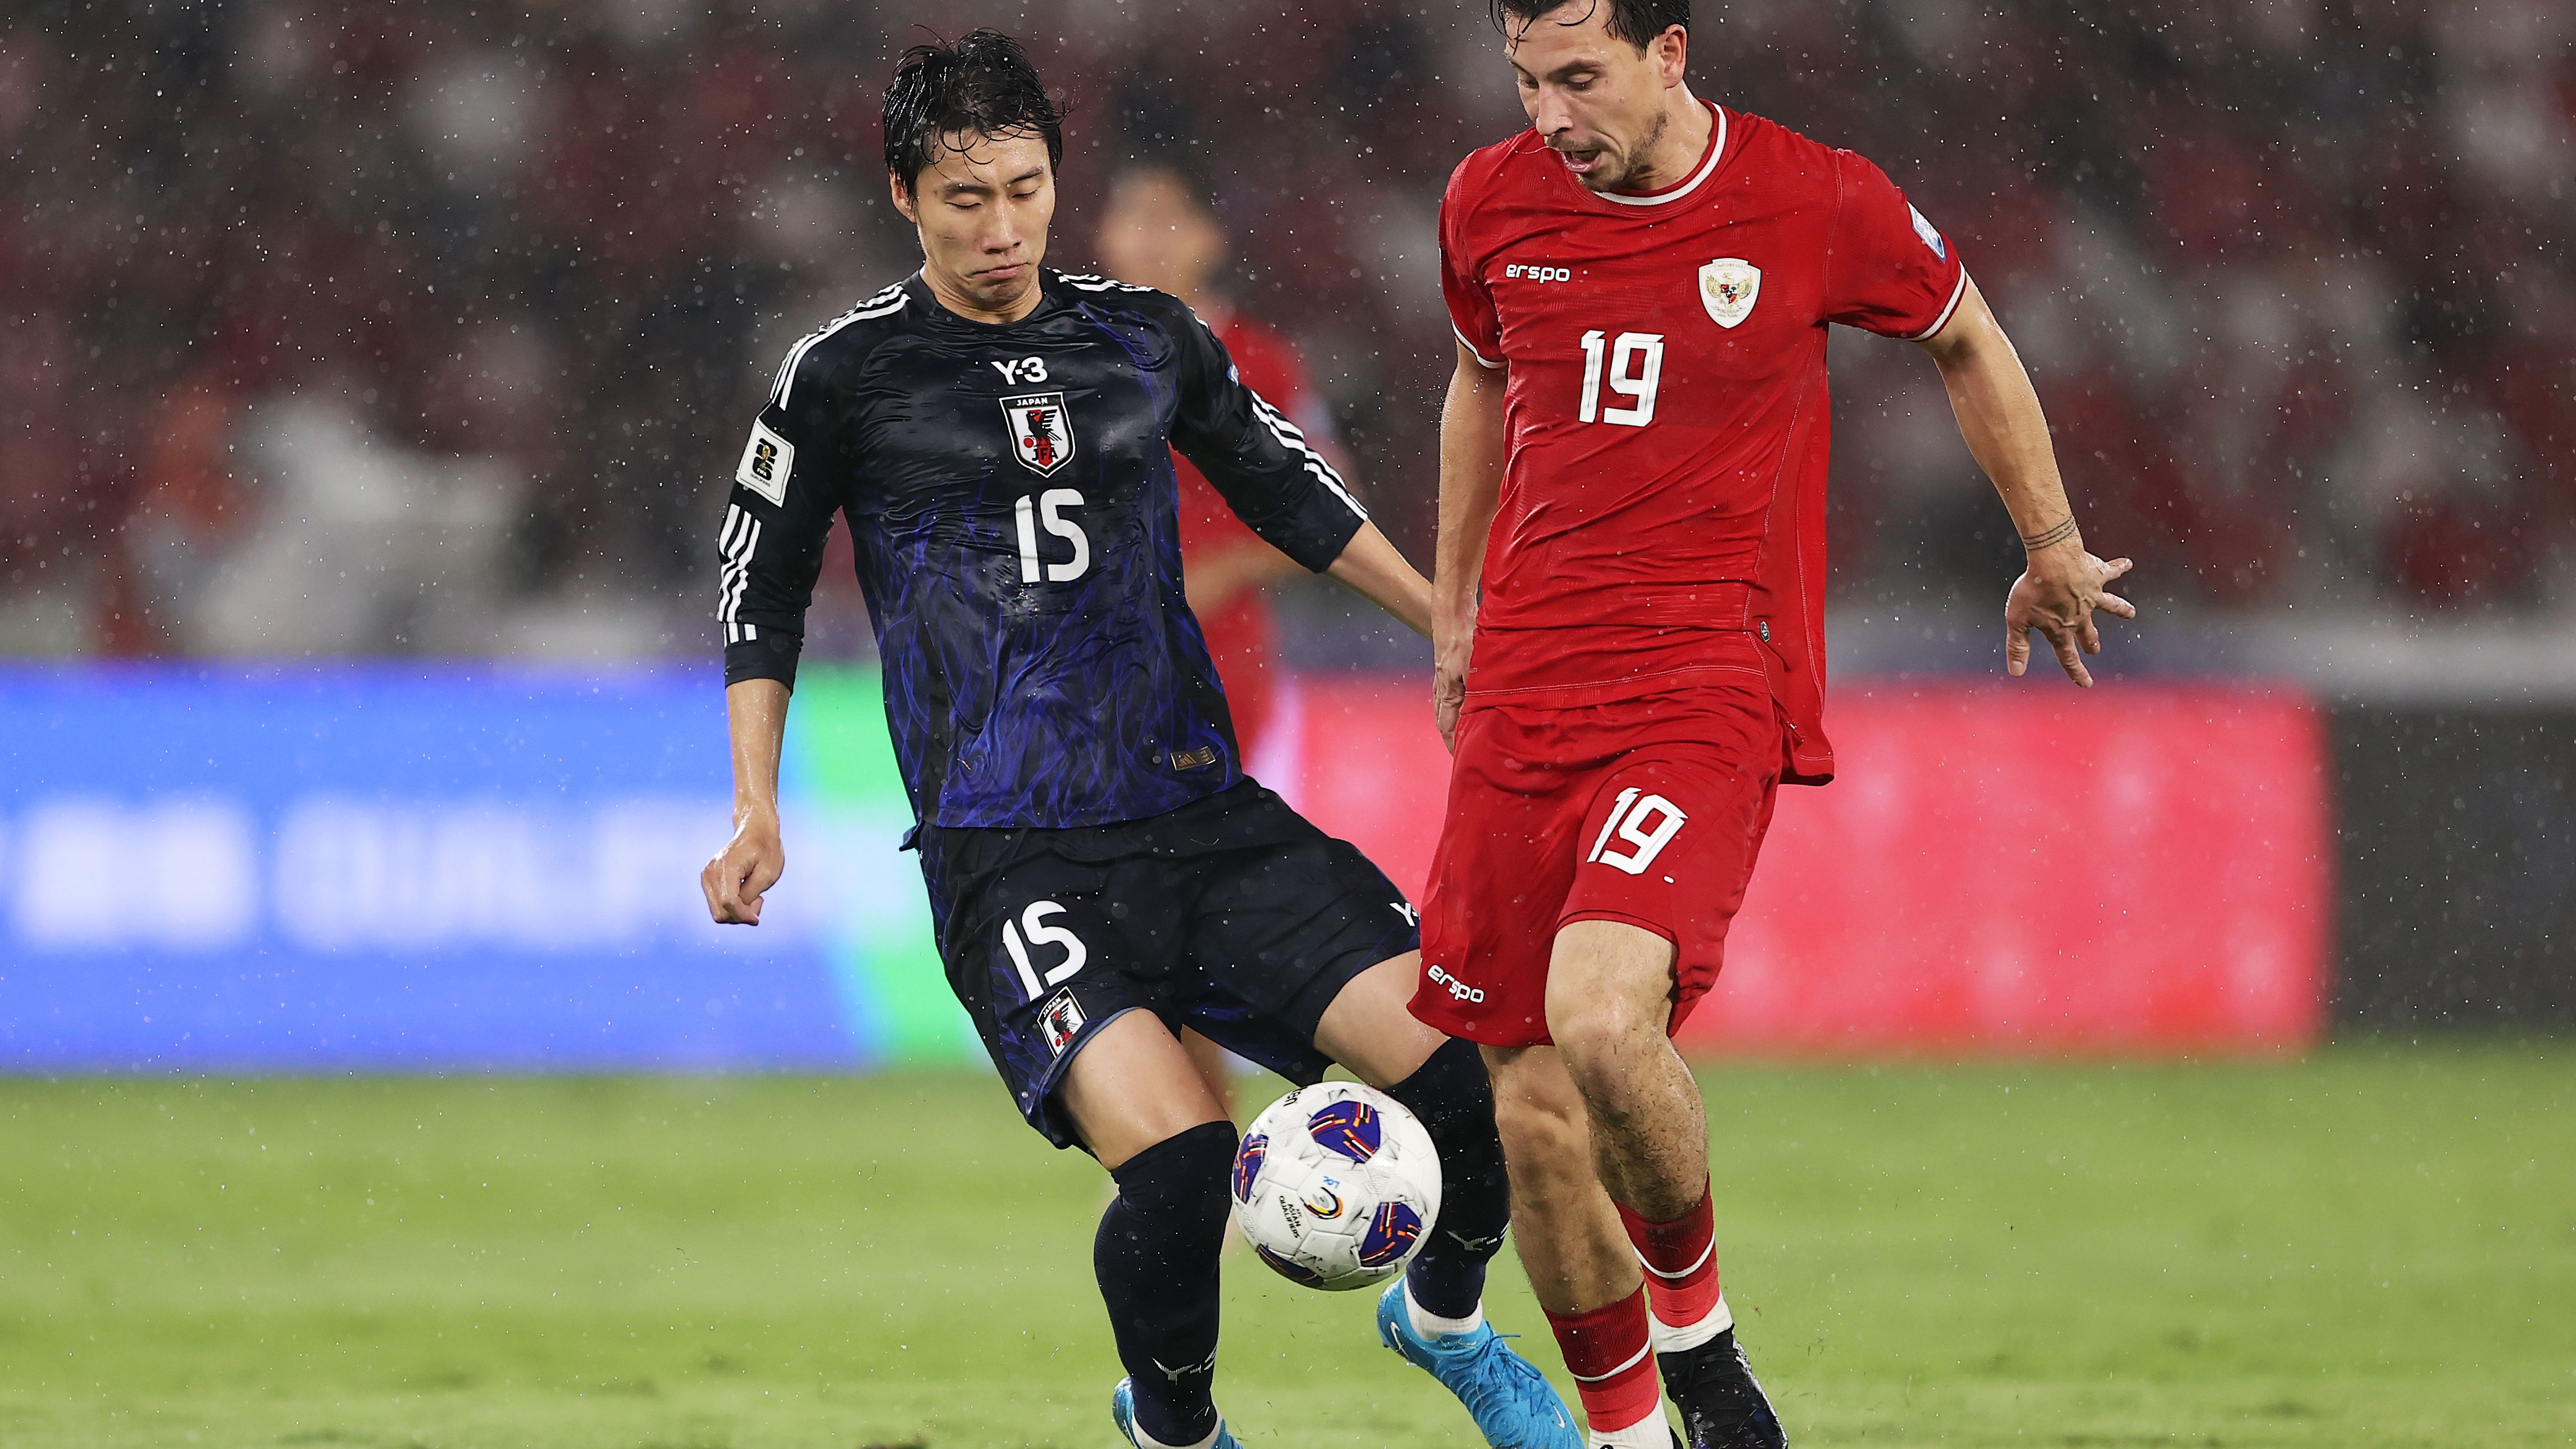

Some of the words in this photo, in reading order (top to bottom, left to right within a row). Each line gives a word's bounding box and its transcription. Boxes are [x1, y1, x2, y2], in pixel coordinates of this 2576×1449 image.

[1506, 265, 1570, 284] erspo
[990, 356, 1048, 385] Y-3
[1579, 330, 1664, 427] 19
[1017, 397, 1048, 406] JAPAN
[1032, 448, 1058, 461] JFA
[757, 468, 767, 477] FIFA
[1016, 488, 1089, 583] 15
[1586, 787, 1688, 875] 19
[1389, 902, 1421, 926] Y-
[1003, 900, 1087, 1002] 15
[1428, 965, 1484, 1003] erspo
[1043, 997, 1061, 1018] JAPAN
[1279, 1195, 1300, 1238] QUALIFIERS
[1287, 1204, 1301, 1227] ASIAN
